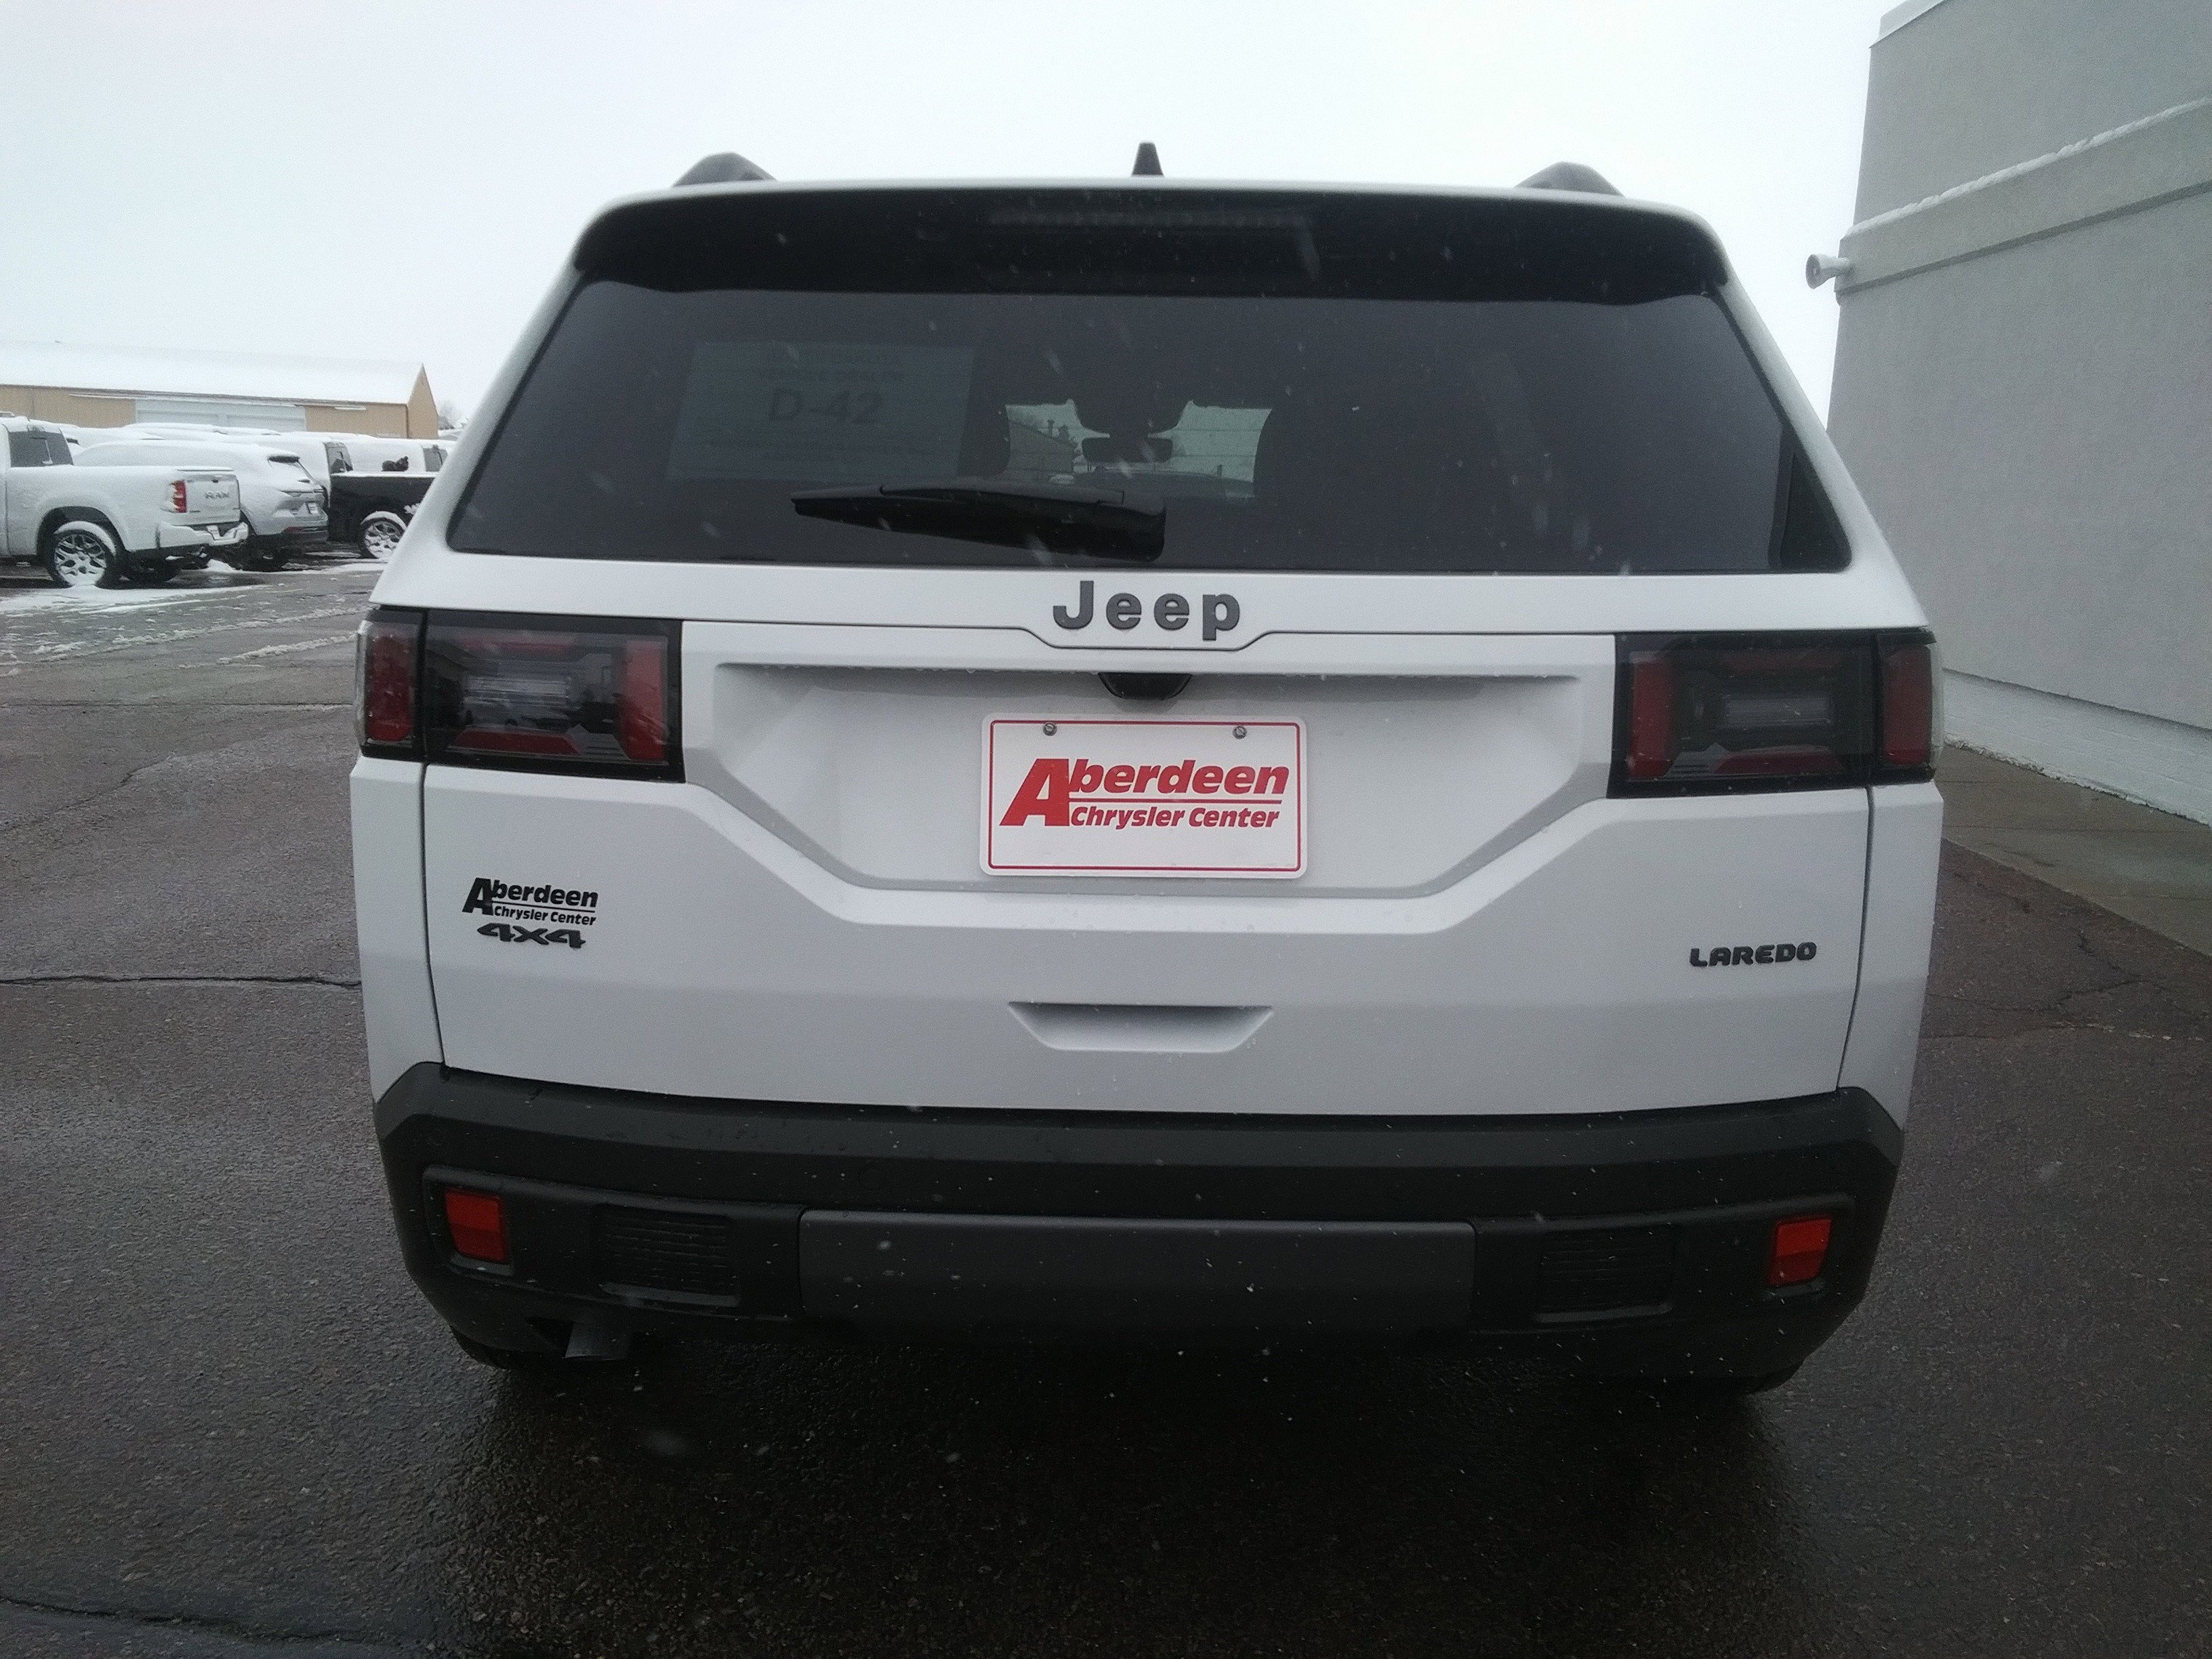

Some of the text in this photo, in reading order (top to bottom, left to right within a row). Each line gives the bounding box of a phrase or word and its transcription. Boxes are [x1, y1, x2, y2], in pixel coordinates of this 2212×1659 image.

[769, 387, 883, 424] D-42
[1052, 580, 1240, 641] Jeep
[1000, 758, 1290, 827] Aberdeen
[1071, 806, 1280, 830] Chrysler Center
[462, 877, 598, 916] Aberdeen
[494, 905, 597, 926] Chrysler Center
[1689, 941, 1818, 968] LAREDO
